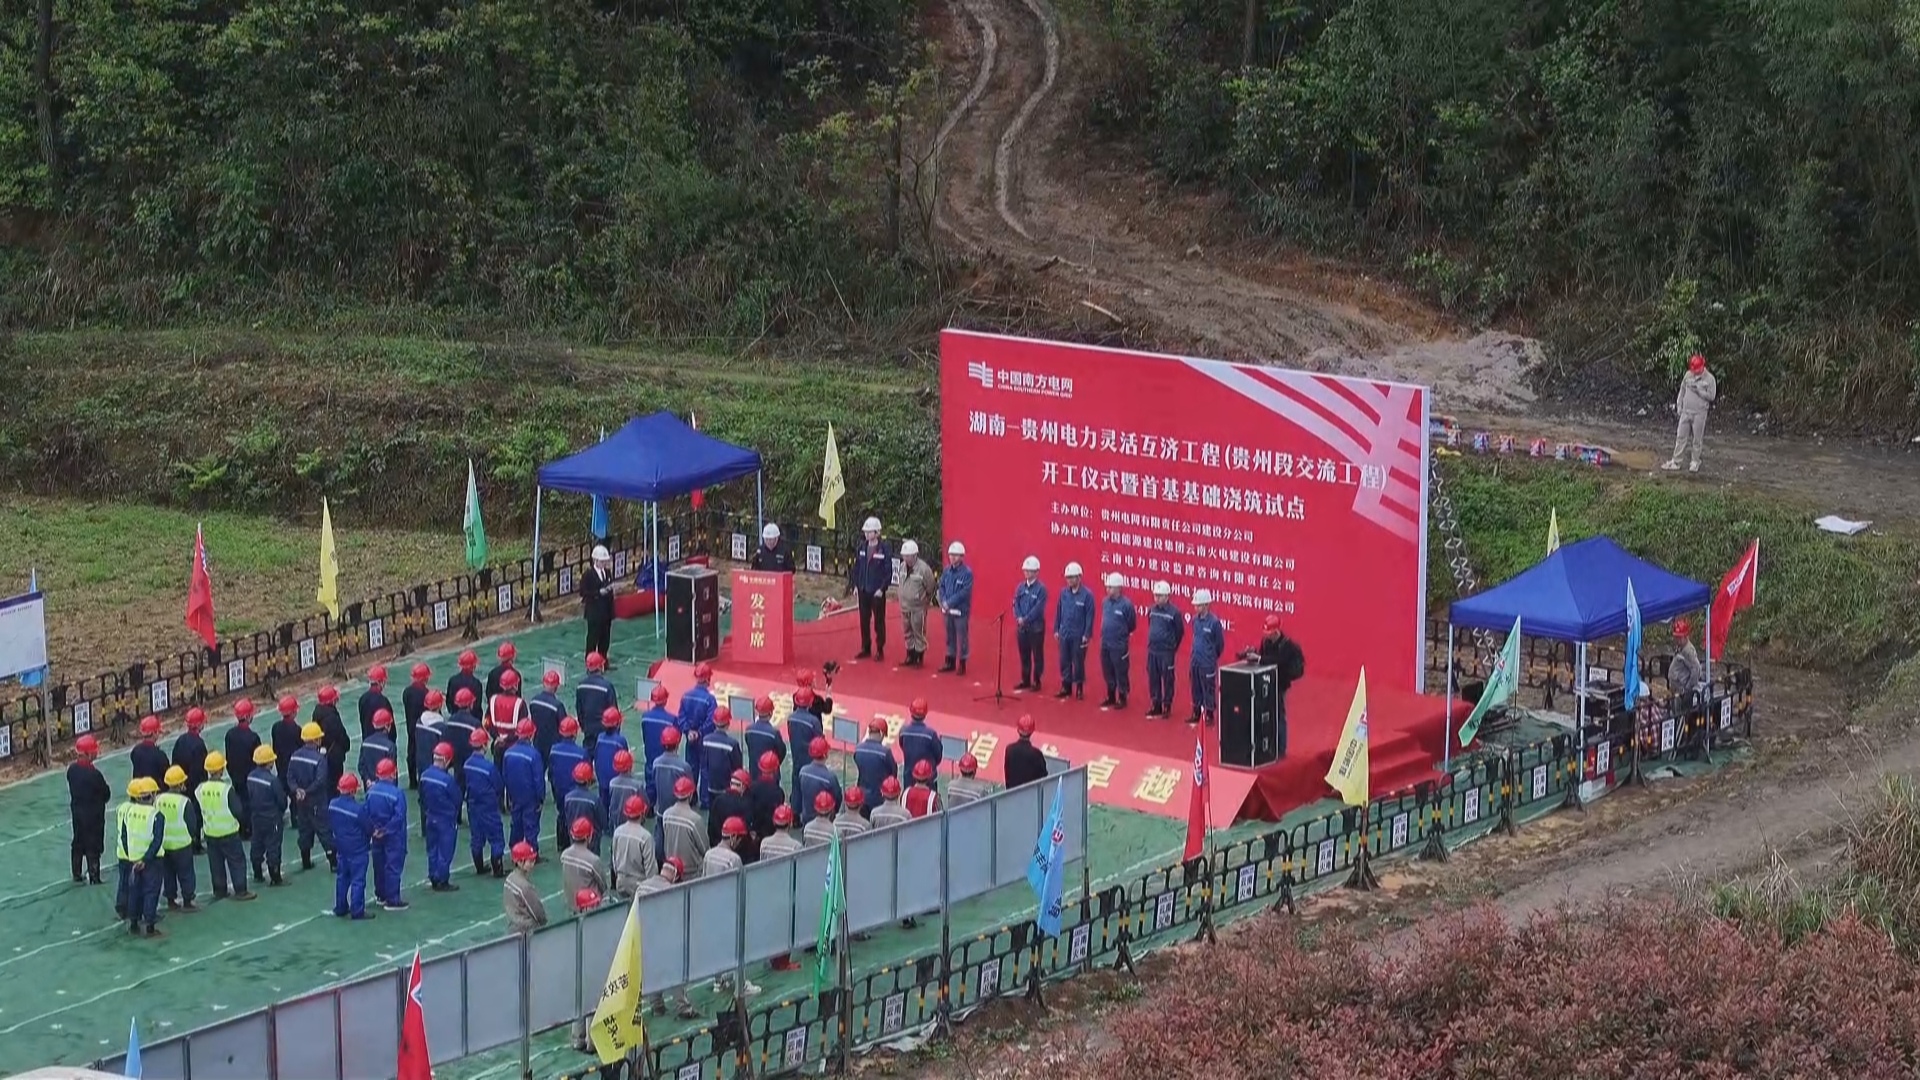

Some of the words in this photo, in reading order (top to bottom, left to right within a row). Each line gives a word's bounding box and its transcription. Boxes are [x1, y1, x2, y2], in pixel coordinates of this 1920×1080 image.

[997, 369, 1073, 393] 中国南方电网
[1041, 461, 1306, 520] 开工仪式暨首基基础浇筑试点
[1101, 508, 1254, 543] 贵州电网有限责任公司建设分公司
[1101, 529, 1295, 571] 中国能源建设集团云南火电建设有限公司
[1101, 551, 1295, 593] 云南电力建设监理咨询有限责任公司
[750, 593, 765, 648] 发言席
